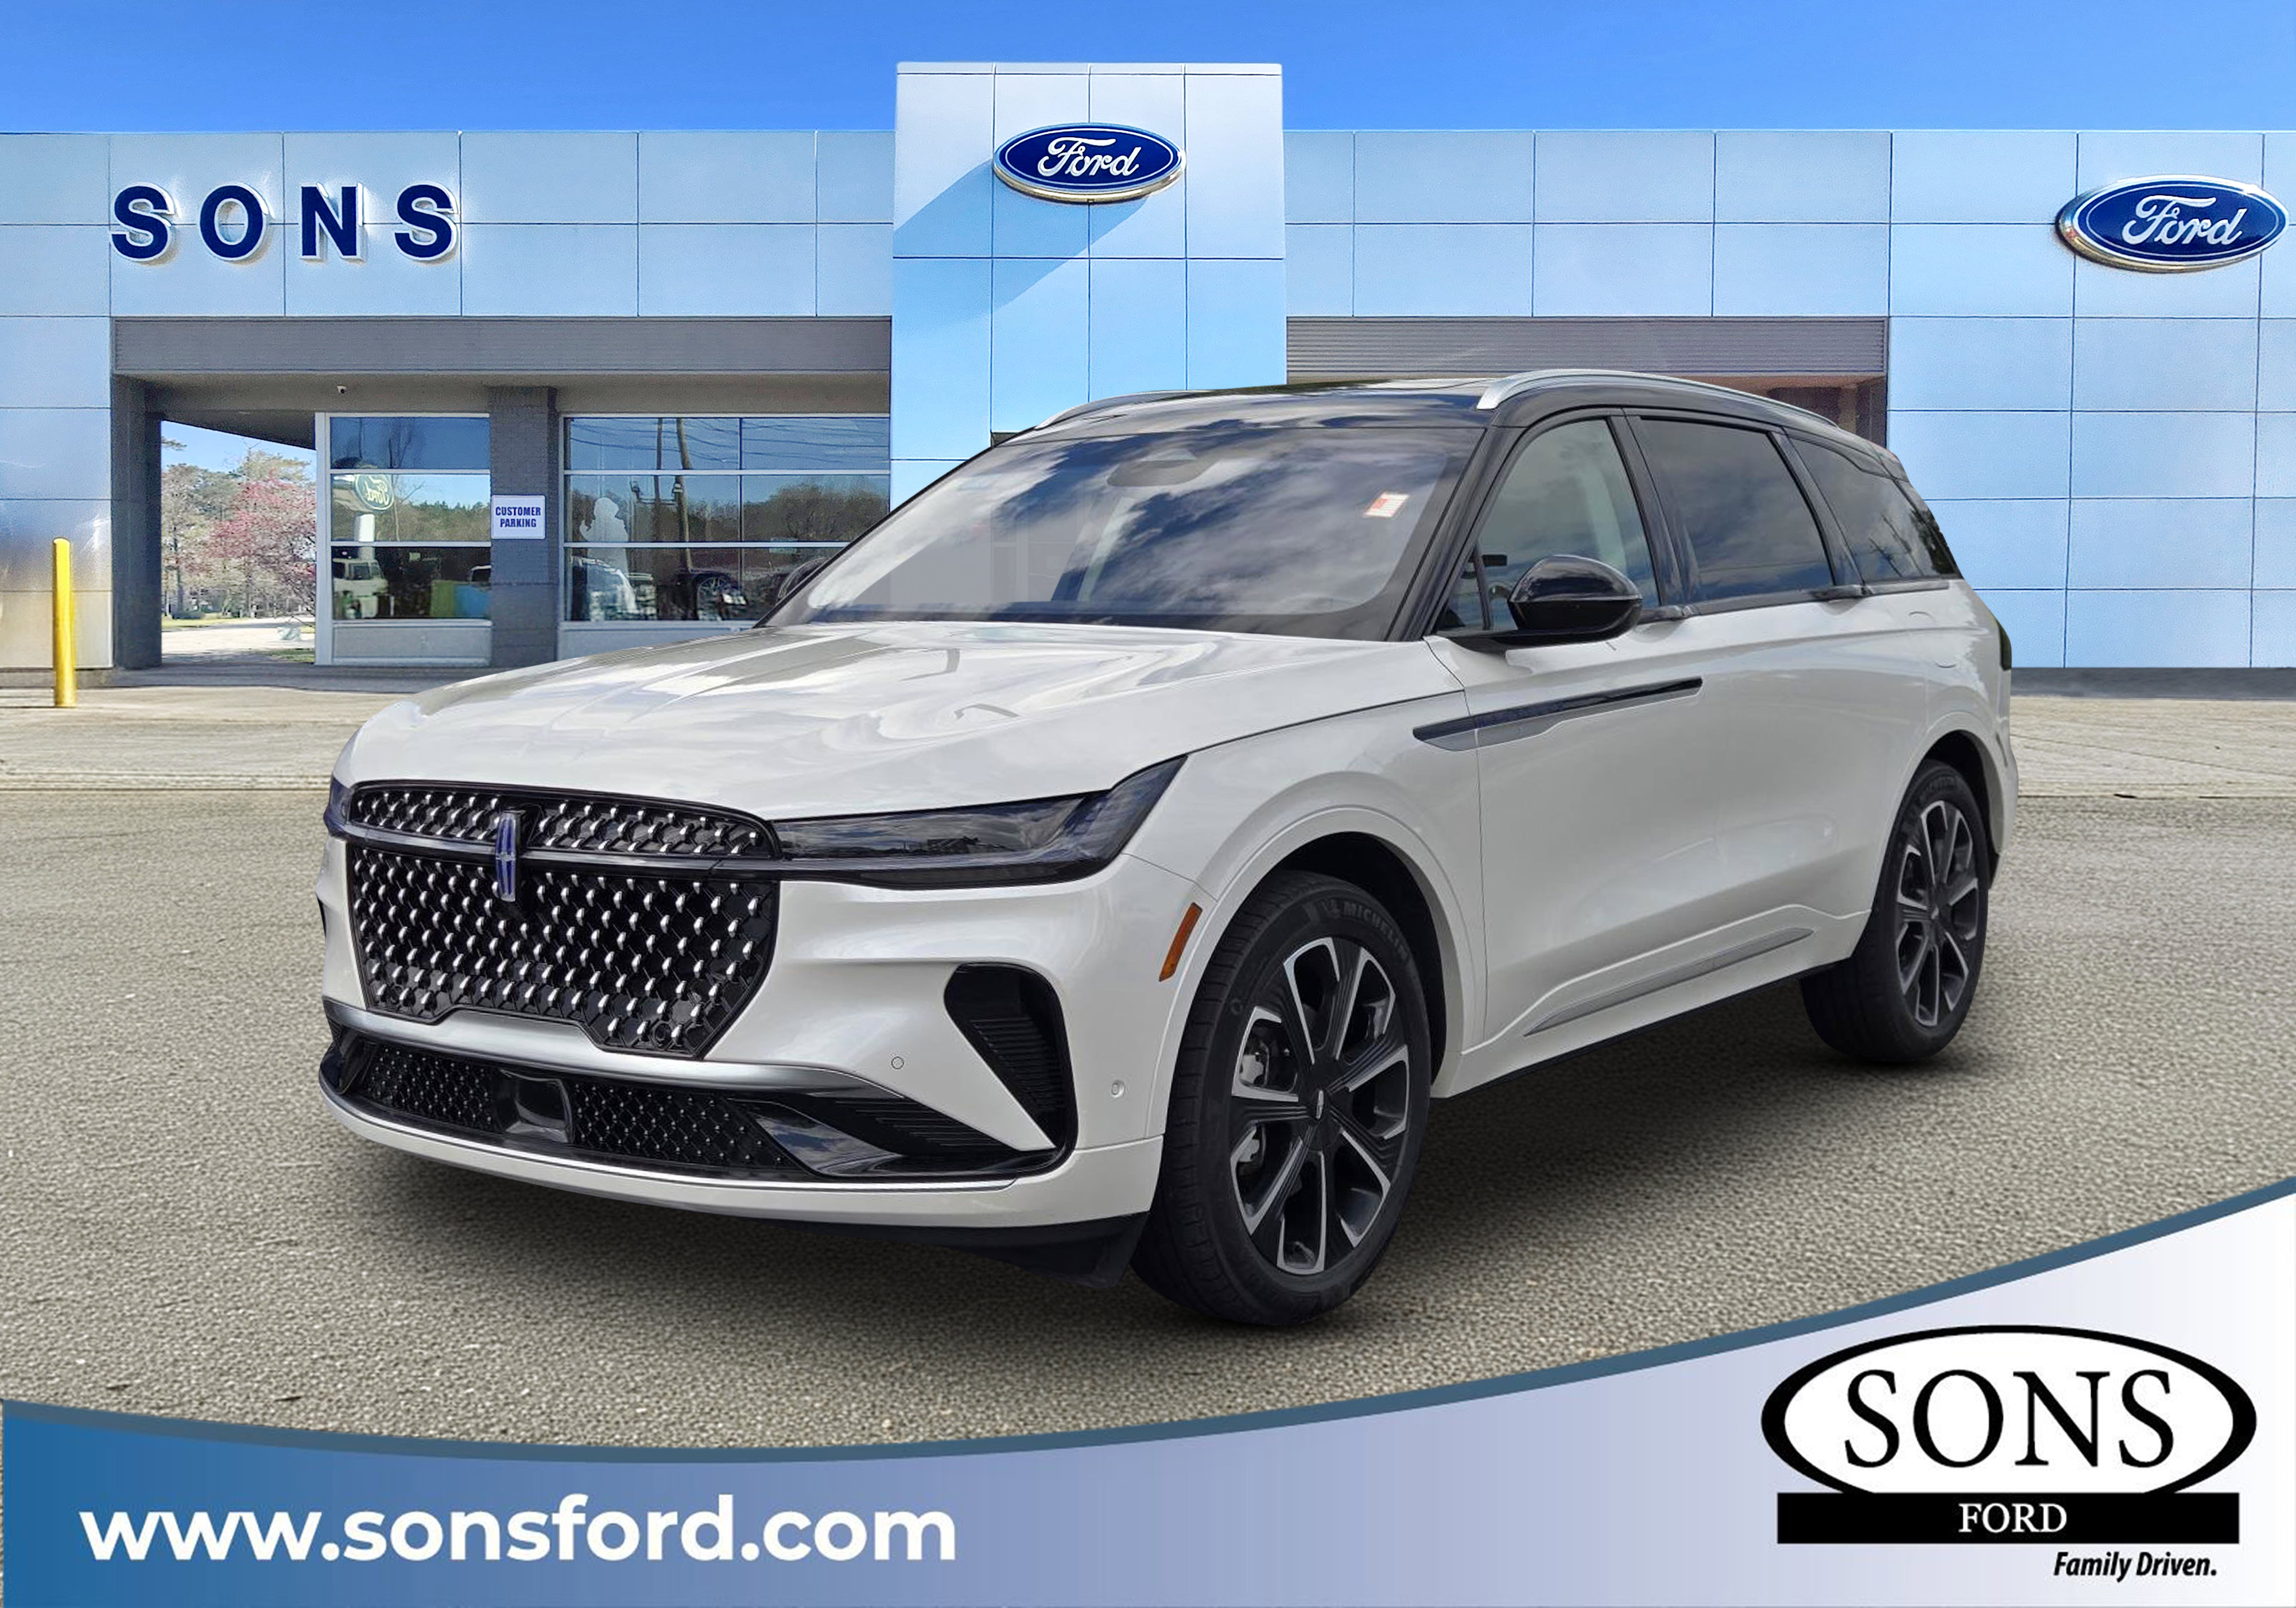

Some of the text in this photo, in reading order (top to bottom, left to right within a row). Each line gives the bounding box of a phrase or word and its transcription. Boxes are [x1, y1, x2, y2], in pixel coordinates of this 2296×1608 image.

[1037, 137, 1142, 176] Ford
[111, 184, 456, 260] SONS
[2122, 195, 2248, 245] Ford
[495, 507, 541, 516] CUSTOMER
[500, 518, 536, 527] PARKING
[1343, 901, 1408, 961] MICHELIN
